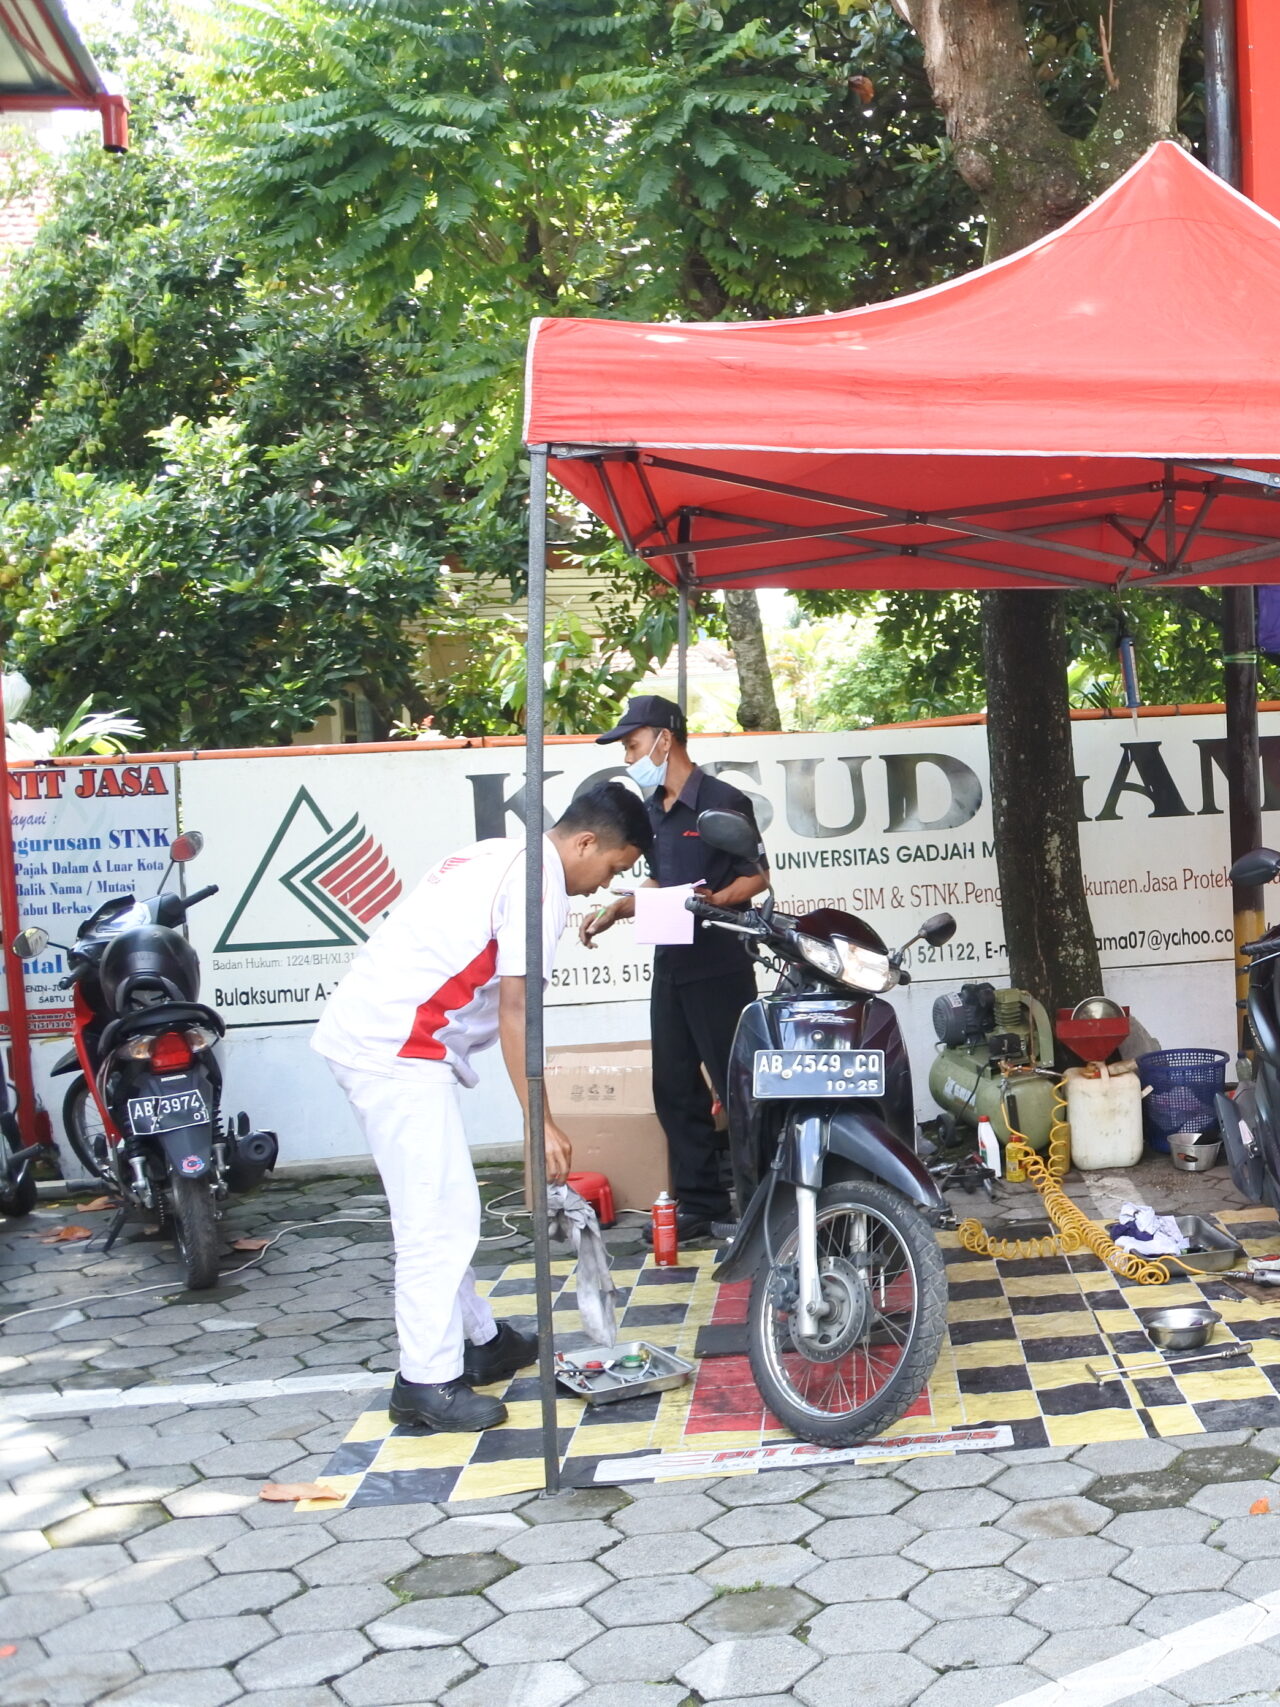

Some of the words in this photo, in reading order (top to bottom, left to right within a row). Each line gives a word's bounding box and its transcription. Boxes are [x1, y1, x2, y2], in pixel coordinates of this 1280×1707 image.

[74, 765, 169, 799] JASA
[108, 827, 171, 849] STNK
[52, 858, 89, 875] Dalam
[92, 860, 102, 874] &
[106, 858, 133, 873] Luar
[137, 857, 164, 872] Kota
[775, 846, 890, 870] UNIVERSITAS
[896, 841, 975, 863] GADJAH
[50, 881, 83, 896] Nama
[97, 878, 136, 894] Mutasi
[52, 901, 93, 916] Berkas
[852, 887, 885, 912] SIM
[890, 886, 905, 909] &
[212, 959, 243, 971] Badan
[550, 966, 617, 987] 521123,
[214, 986, 310, 1008] Bulaksumur
[314, 981, 340, 1001] A-
[758, 1054, 783, 1074] AB
[791, 1053, 841, 1073] 4549
[826, 1079, 879, 1092] 10-25
[133, 1098, 154, 1120] AB
[160, 1095, 201, 1115] 3974
